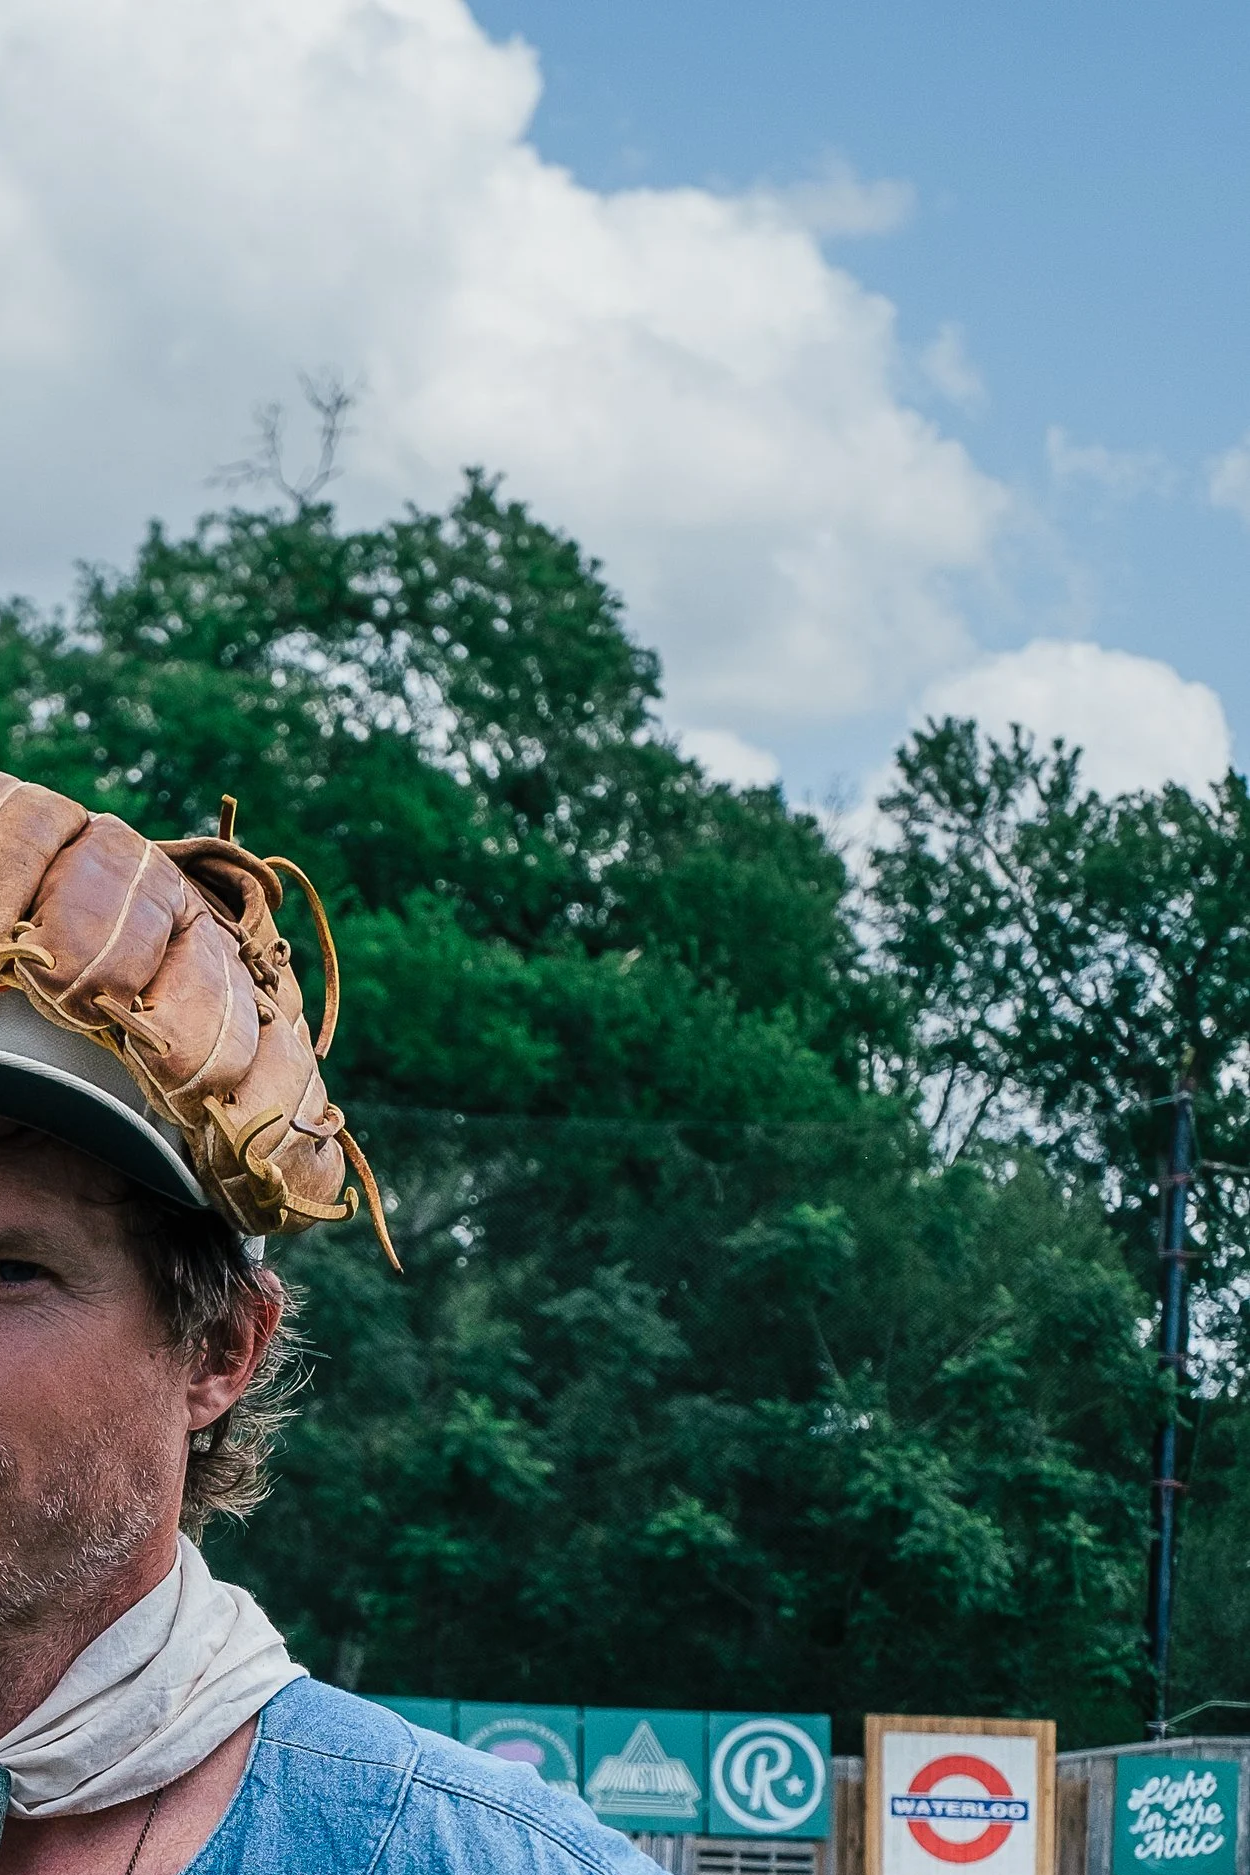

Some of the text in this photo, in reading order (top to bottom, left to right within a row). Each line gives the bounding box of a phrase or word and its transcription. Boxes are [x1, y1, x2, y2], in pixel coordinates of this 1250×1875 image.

[1127, 1769, 1218, 1812] Light
[892, 1798, 1027, 1820] WATERLOO
[1168, 1796, 1225, 1829] the
[1134, 1823, 1225, 1860] Attic
